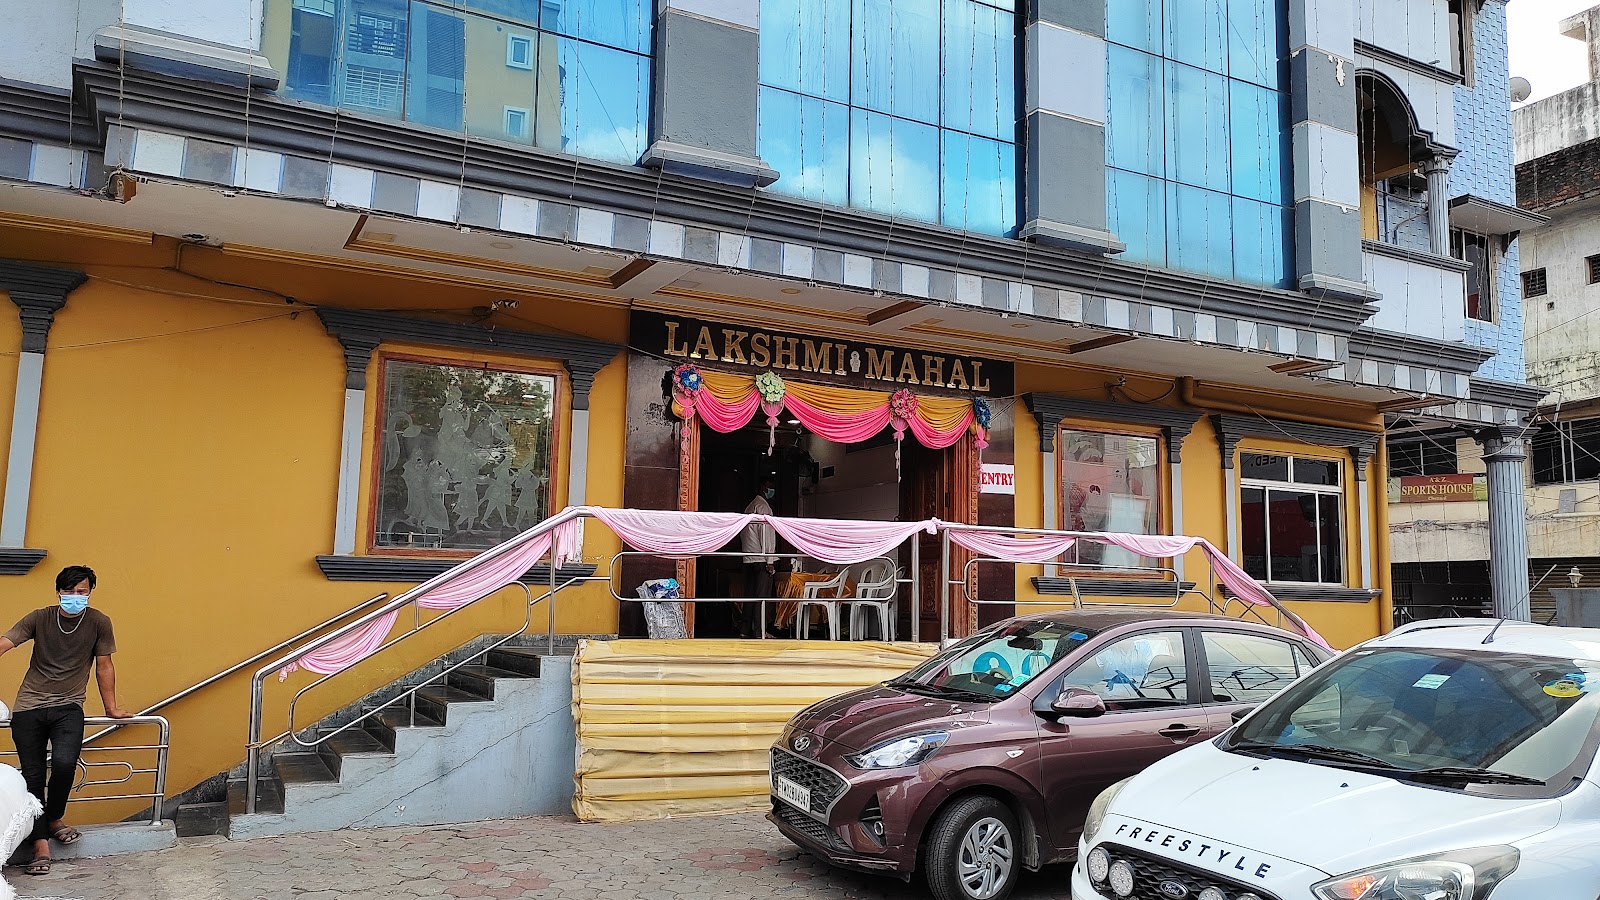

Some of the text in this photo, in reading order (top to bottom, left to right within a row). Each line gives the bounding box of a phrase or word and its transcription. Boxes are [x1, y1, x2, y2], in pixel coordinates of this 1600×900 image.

[663, 321, 991, 391] LAKSHMI MAHAL
[981, 472, 1014, 486] ENTRY
[1401, 483, 1473, 496] SPORTS HOUSE
[1115, 824, 1272, 879] FREESTYLE
